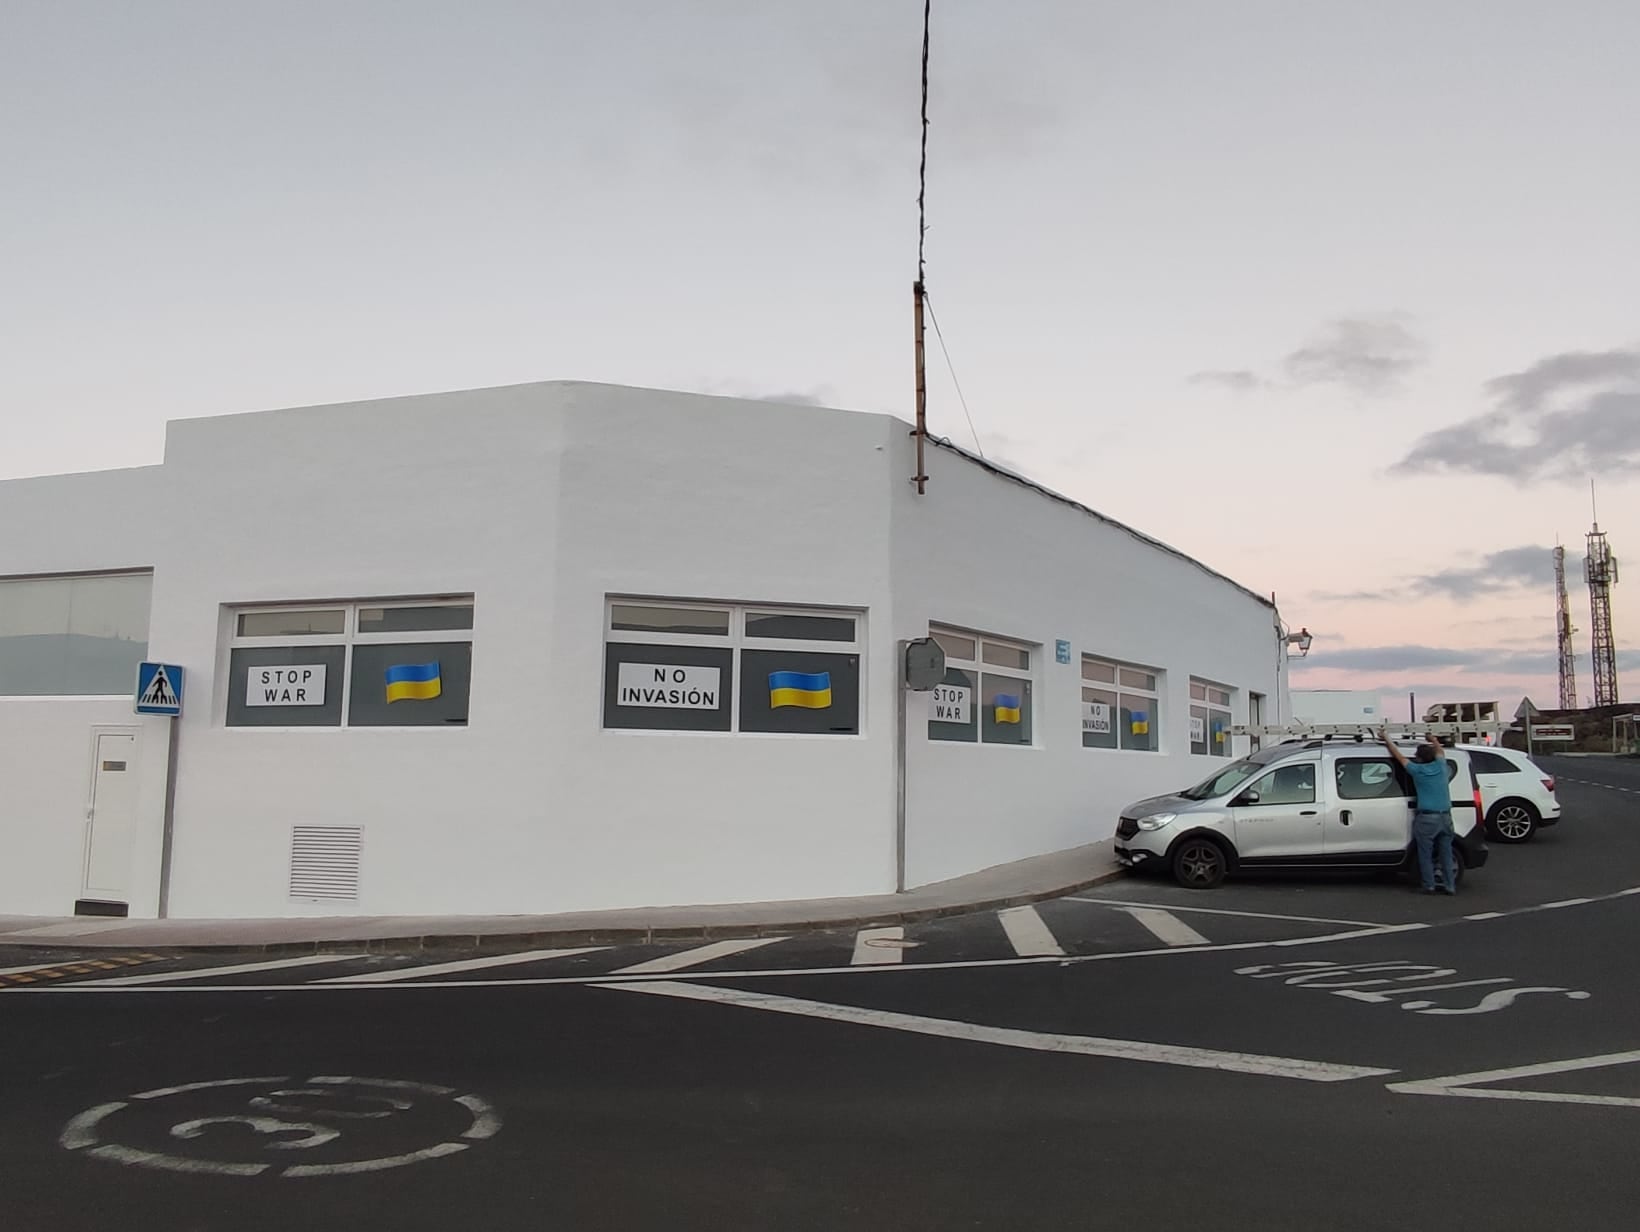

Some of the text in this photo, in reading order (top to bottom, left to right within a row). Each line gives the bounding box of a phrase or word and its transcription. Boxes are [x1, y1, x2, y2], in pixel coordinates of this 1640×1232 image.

[261, 670, 312, 684] STOP
[654, 668, 686, 683] NO
[264, 688, 306, 702] WAR
[622, 687, 714, 706] INVASIÓN
[933, 688, 964, 703] STOP
[935, 704, 961, 720] WAR
